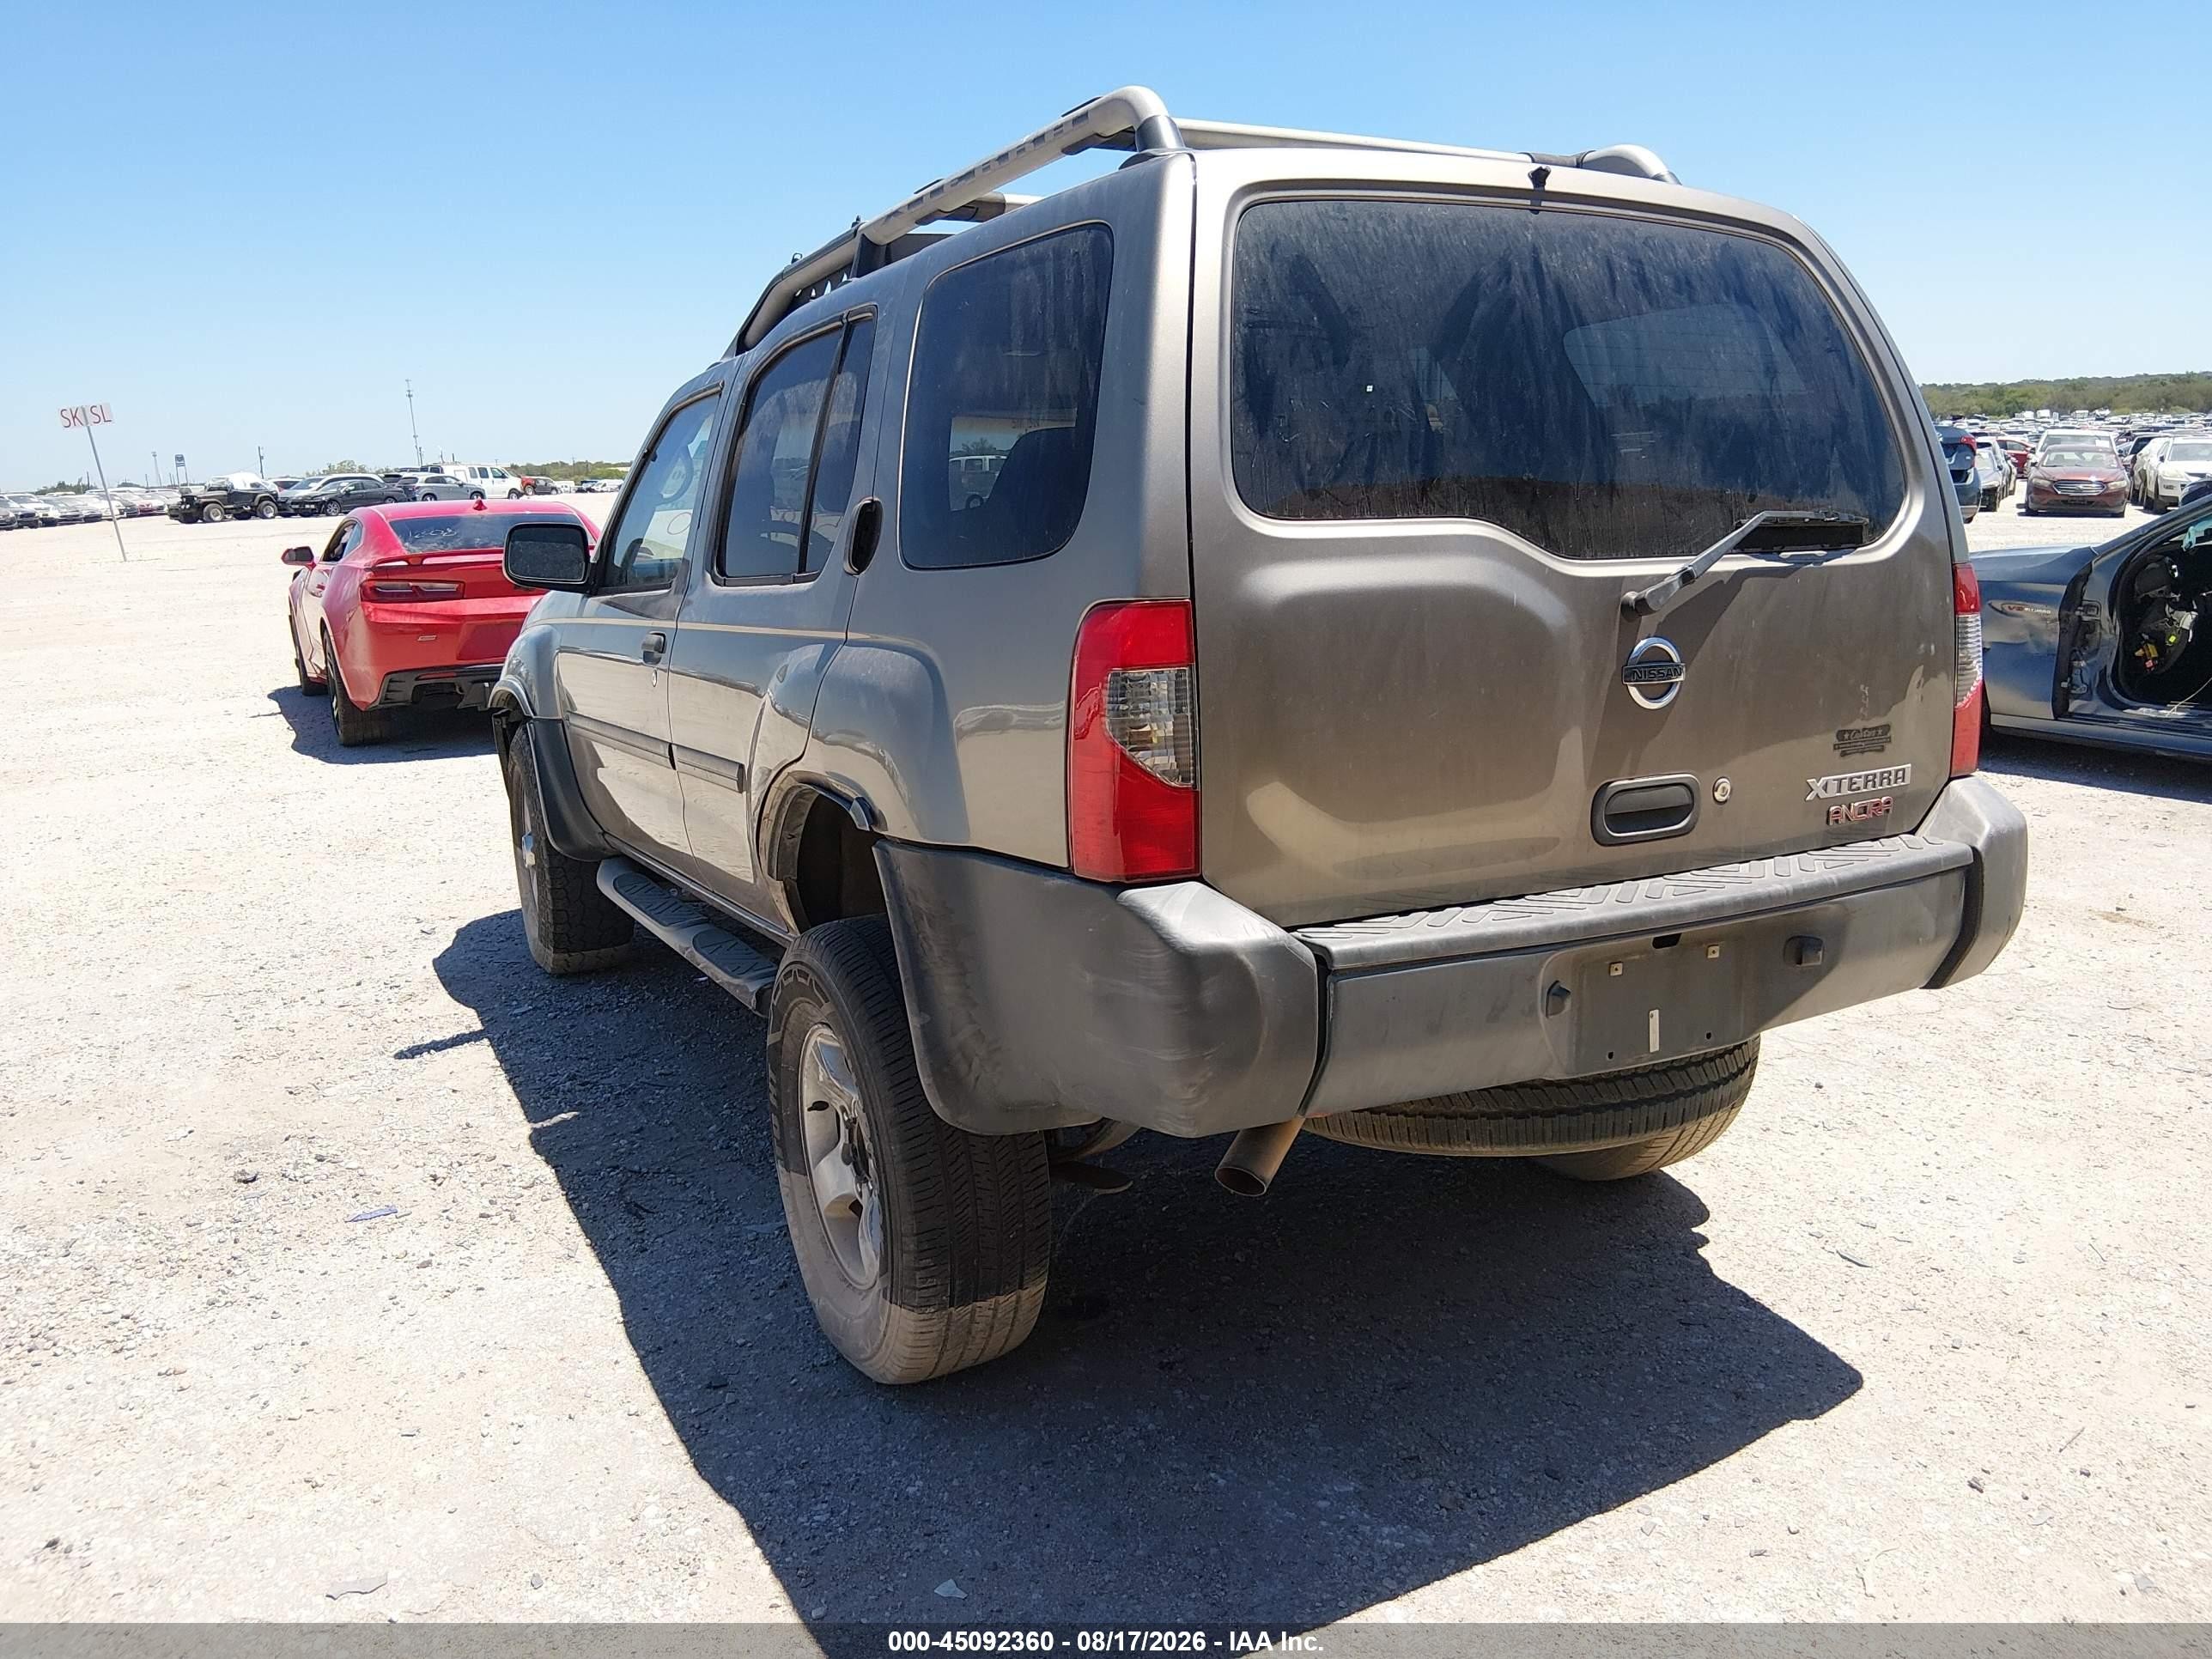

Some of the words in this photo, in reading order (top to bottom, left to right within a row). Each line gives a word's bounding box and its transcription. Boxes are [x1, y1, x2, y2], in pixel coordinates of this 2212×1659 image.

[60, 407, 84, 428] SK
[89, 404, 112, 424] SL
[1631, 666, 1683, 682] NISSAN
[1805, 763, 1912, 802] XTERRA
